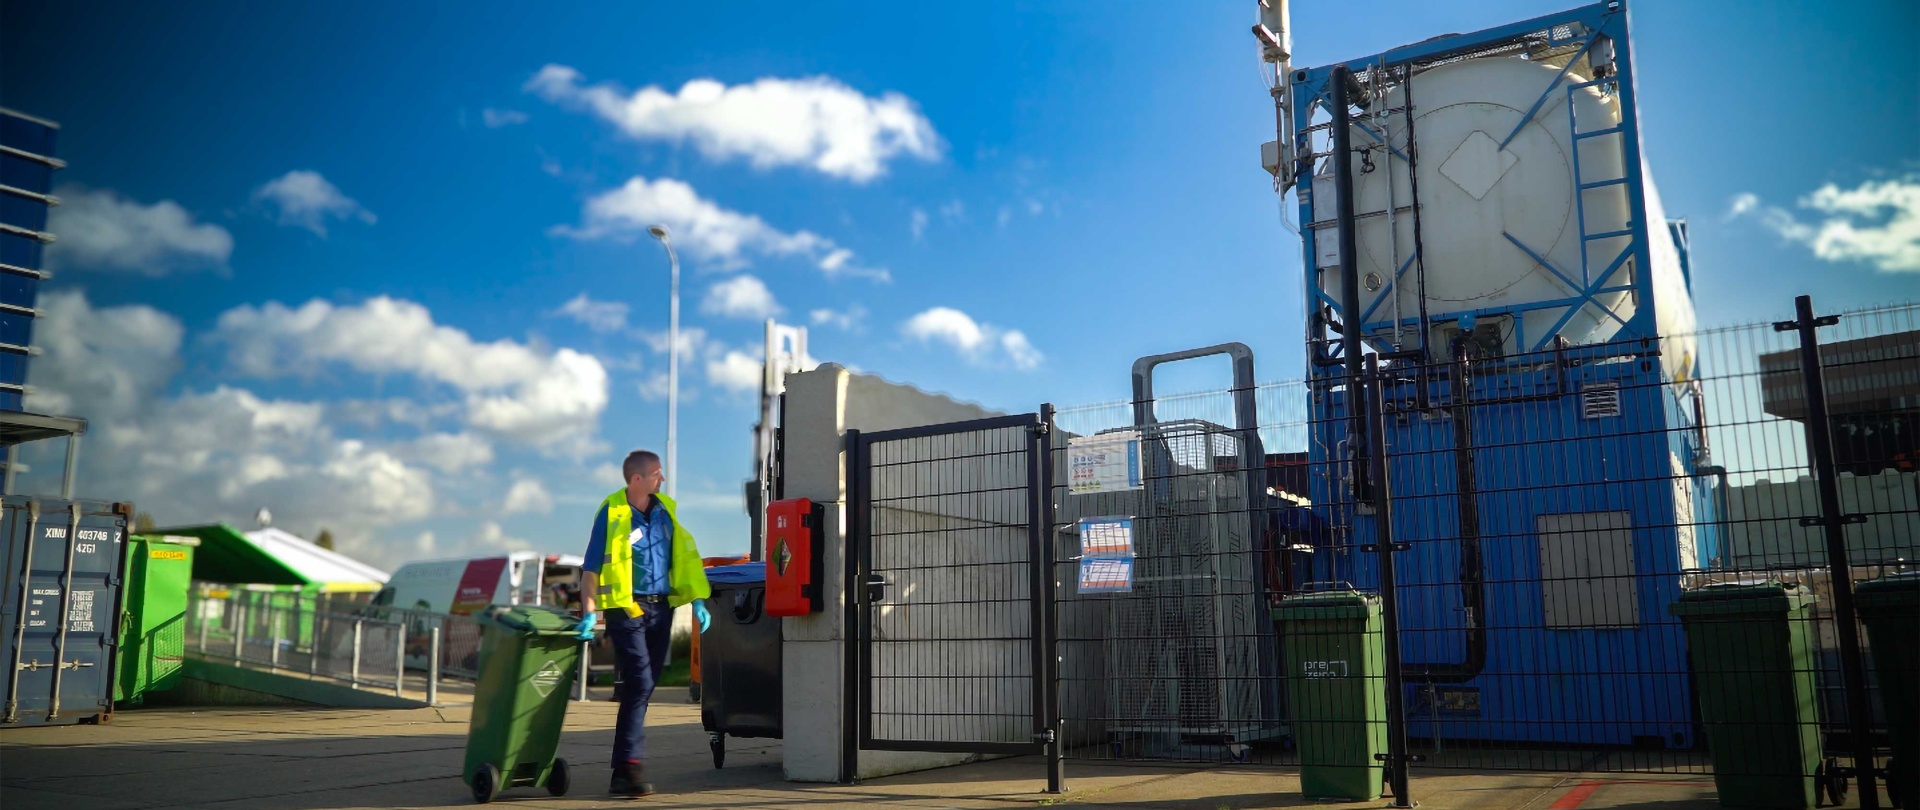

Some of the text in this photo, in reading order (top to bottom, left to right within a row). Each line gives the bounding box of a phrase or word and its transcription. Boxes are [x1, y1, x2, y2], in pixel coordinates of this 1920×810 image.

[45, 528, 66, 538] XINU
[76, 543, 95, 553] 42G1
[1304, 661, 1327, 671] pre
